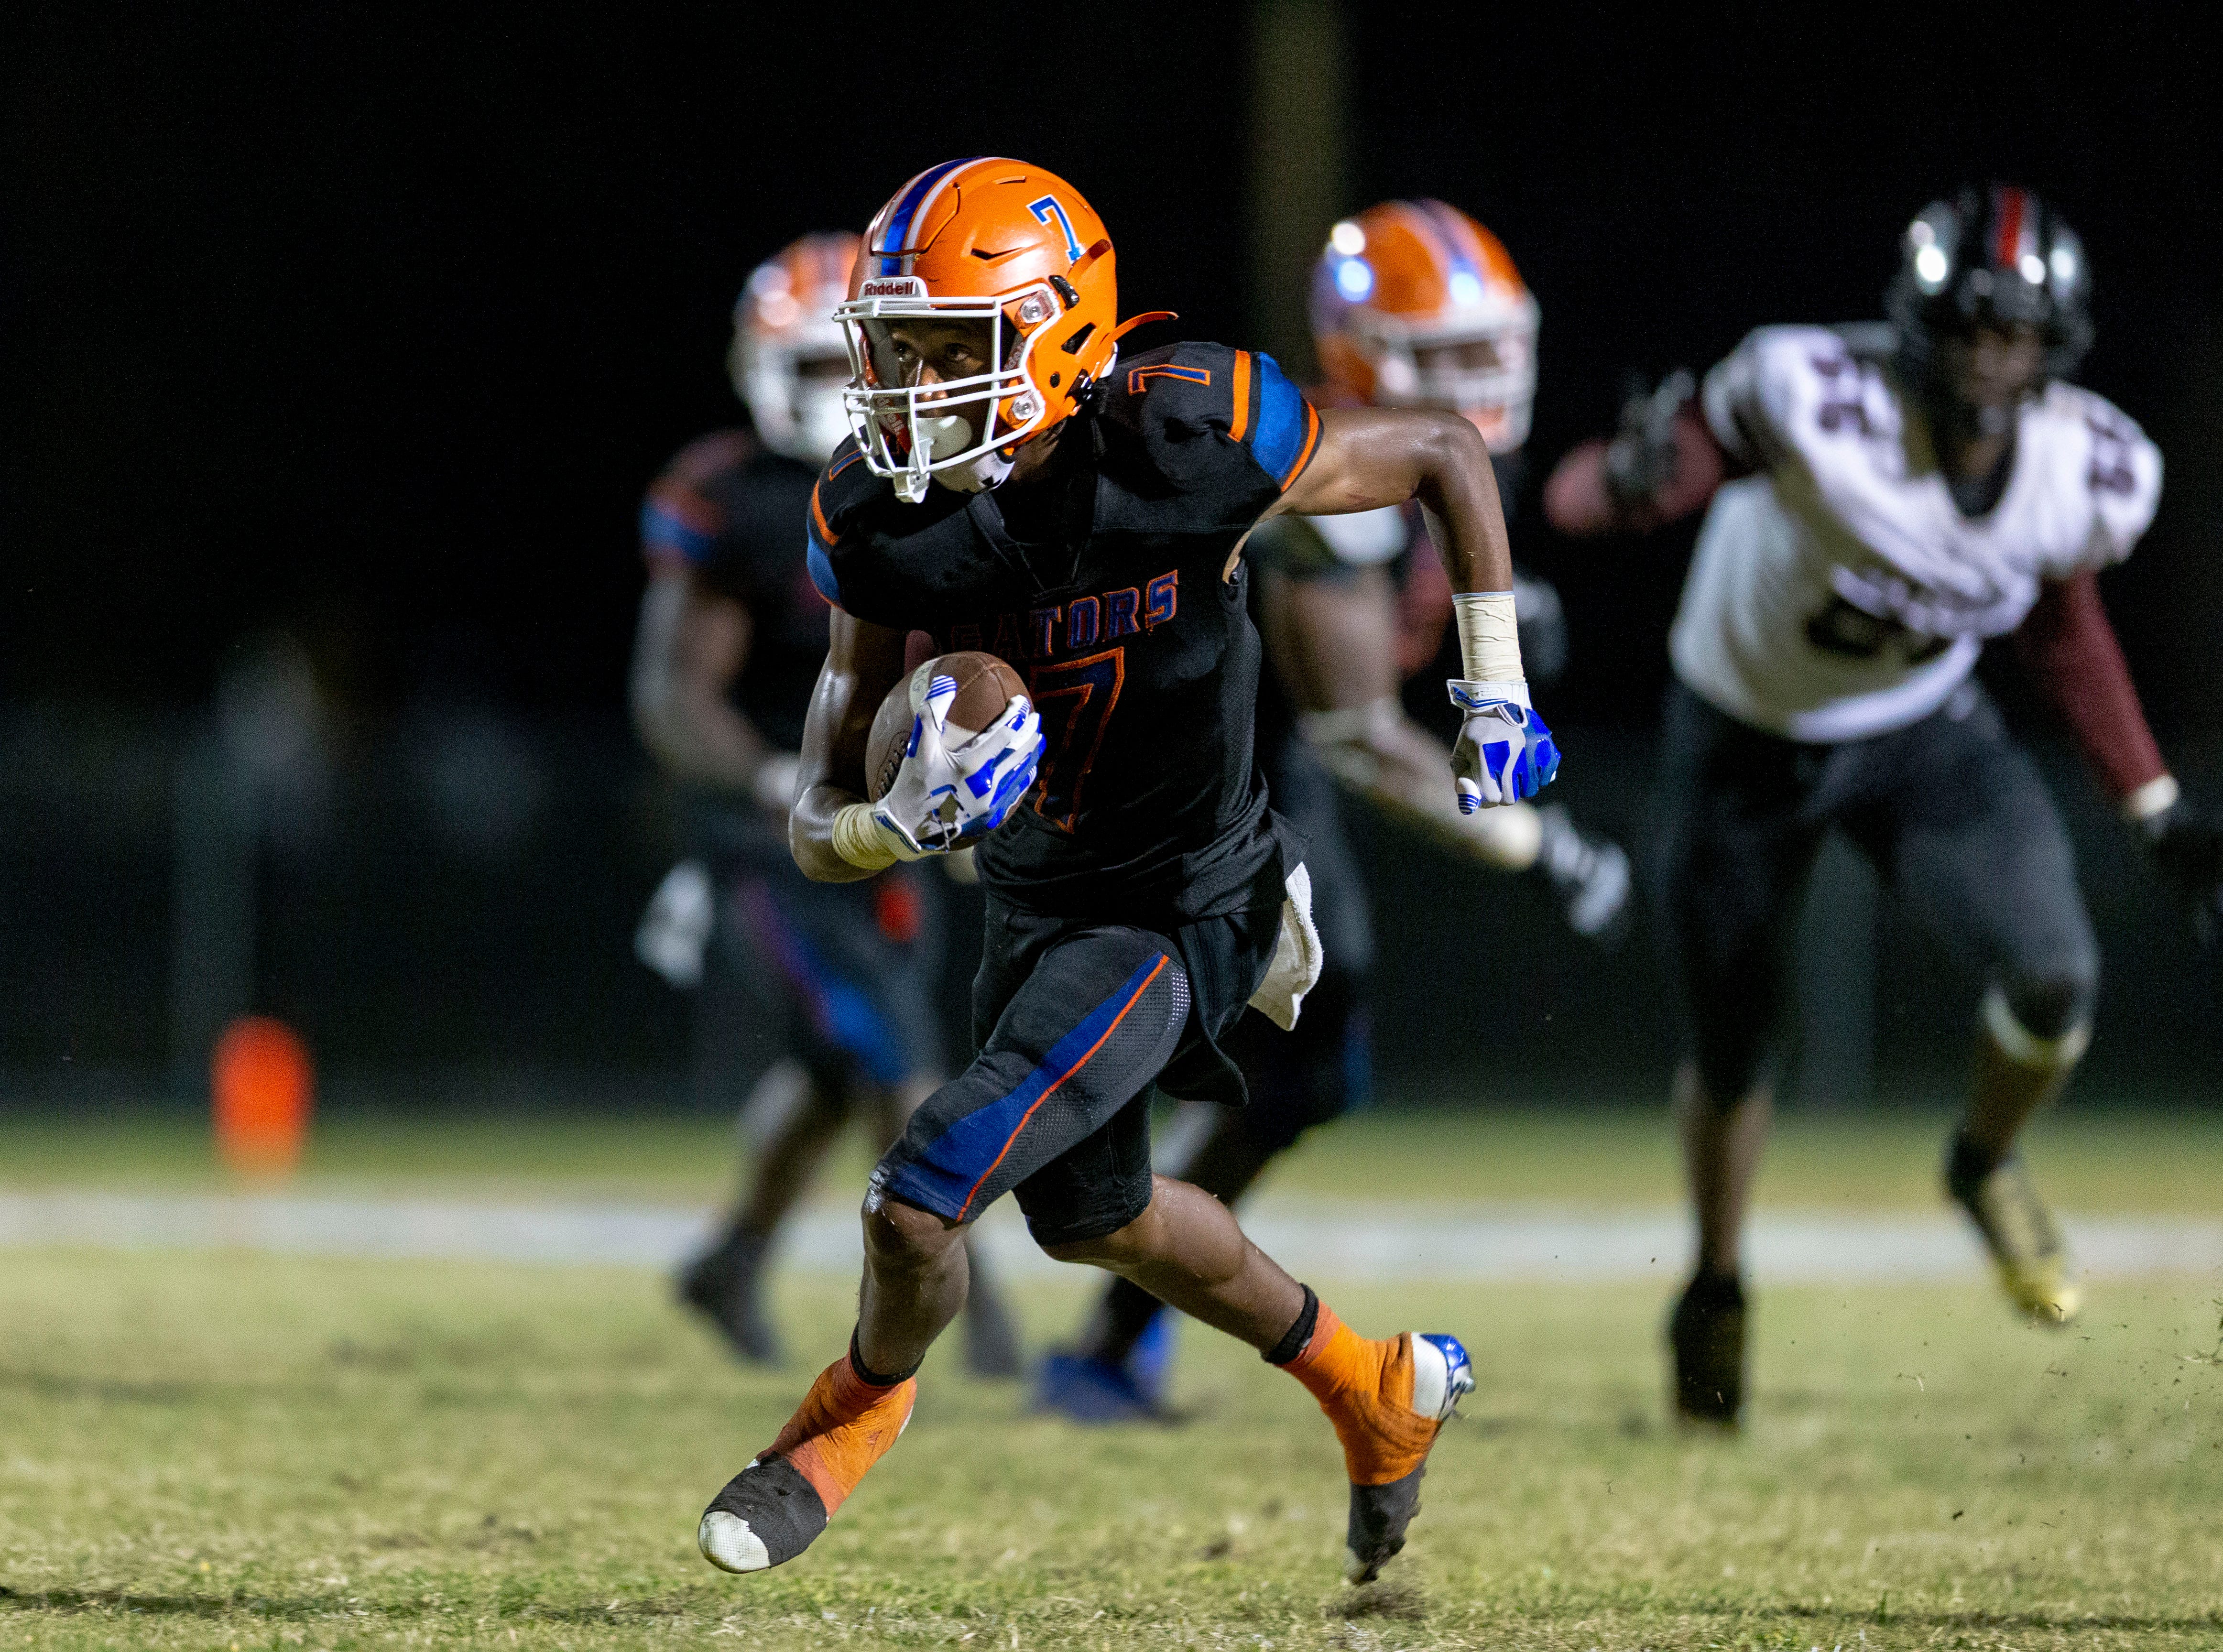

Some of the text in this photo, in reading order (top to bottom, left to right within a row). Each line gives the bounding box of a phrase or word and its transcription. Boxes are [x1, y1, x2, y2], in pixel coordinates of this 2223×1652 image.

[1025, 194, 1086, 264] 7
[864, 282, 914, 295] Riddell
[1129, 364, 1210, 395] 7
[1028, 646, 1125, 834] 7
